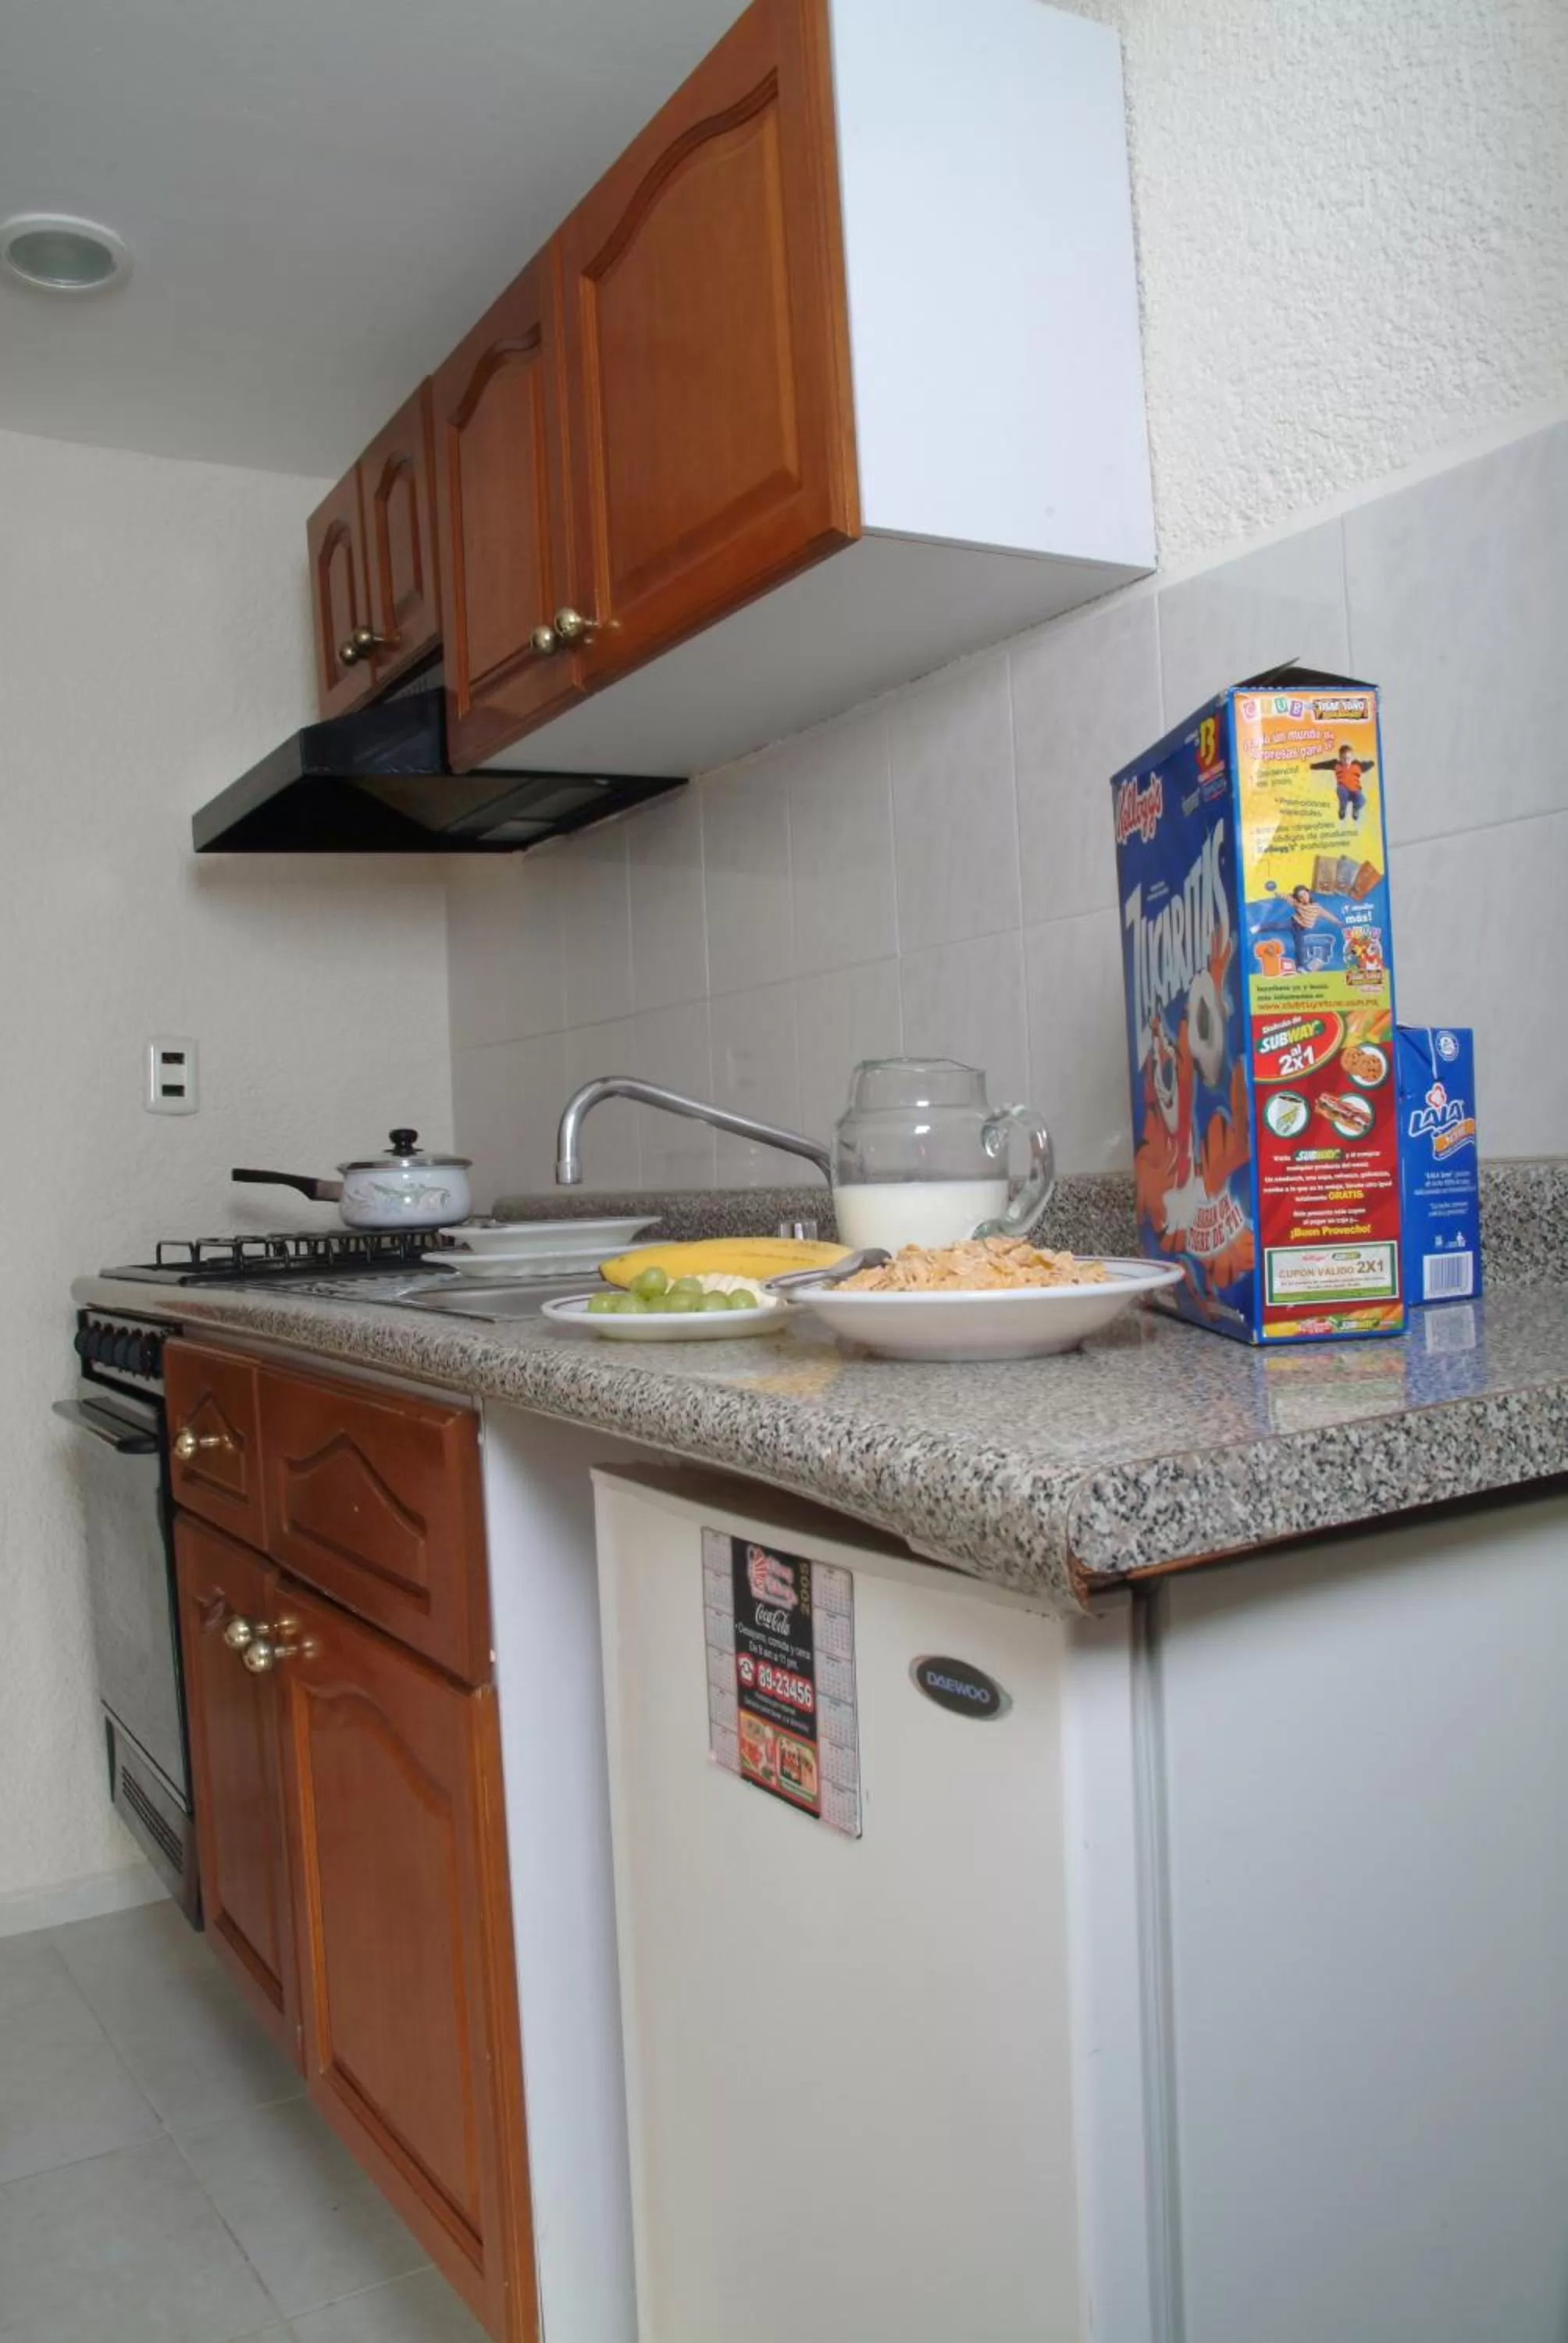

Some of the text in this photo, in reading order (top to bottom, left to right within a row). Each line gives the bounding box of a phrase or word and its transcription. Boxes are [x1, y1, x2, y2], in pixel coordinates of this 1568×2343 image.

[1117, 772, 1163, 845] Kellogg's
[1258, 1020, 1323, 1054] SUBWAY
[1408, 1099, 1465, 1138] LALA
[926, 1671, 990, 1704] DAEWOO
